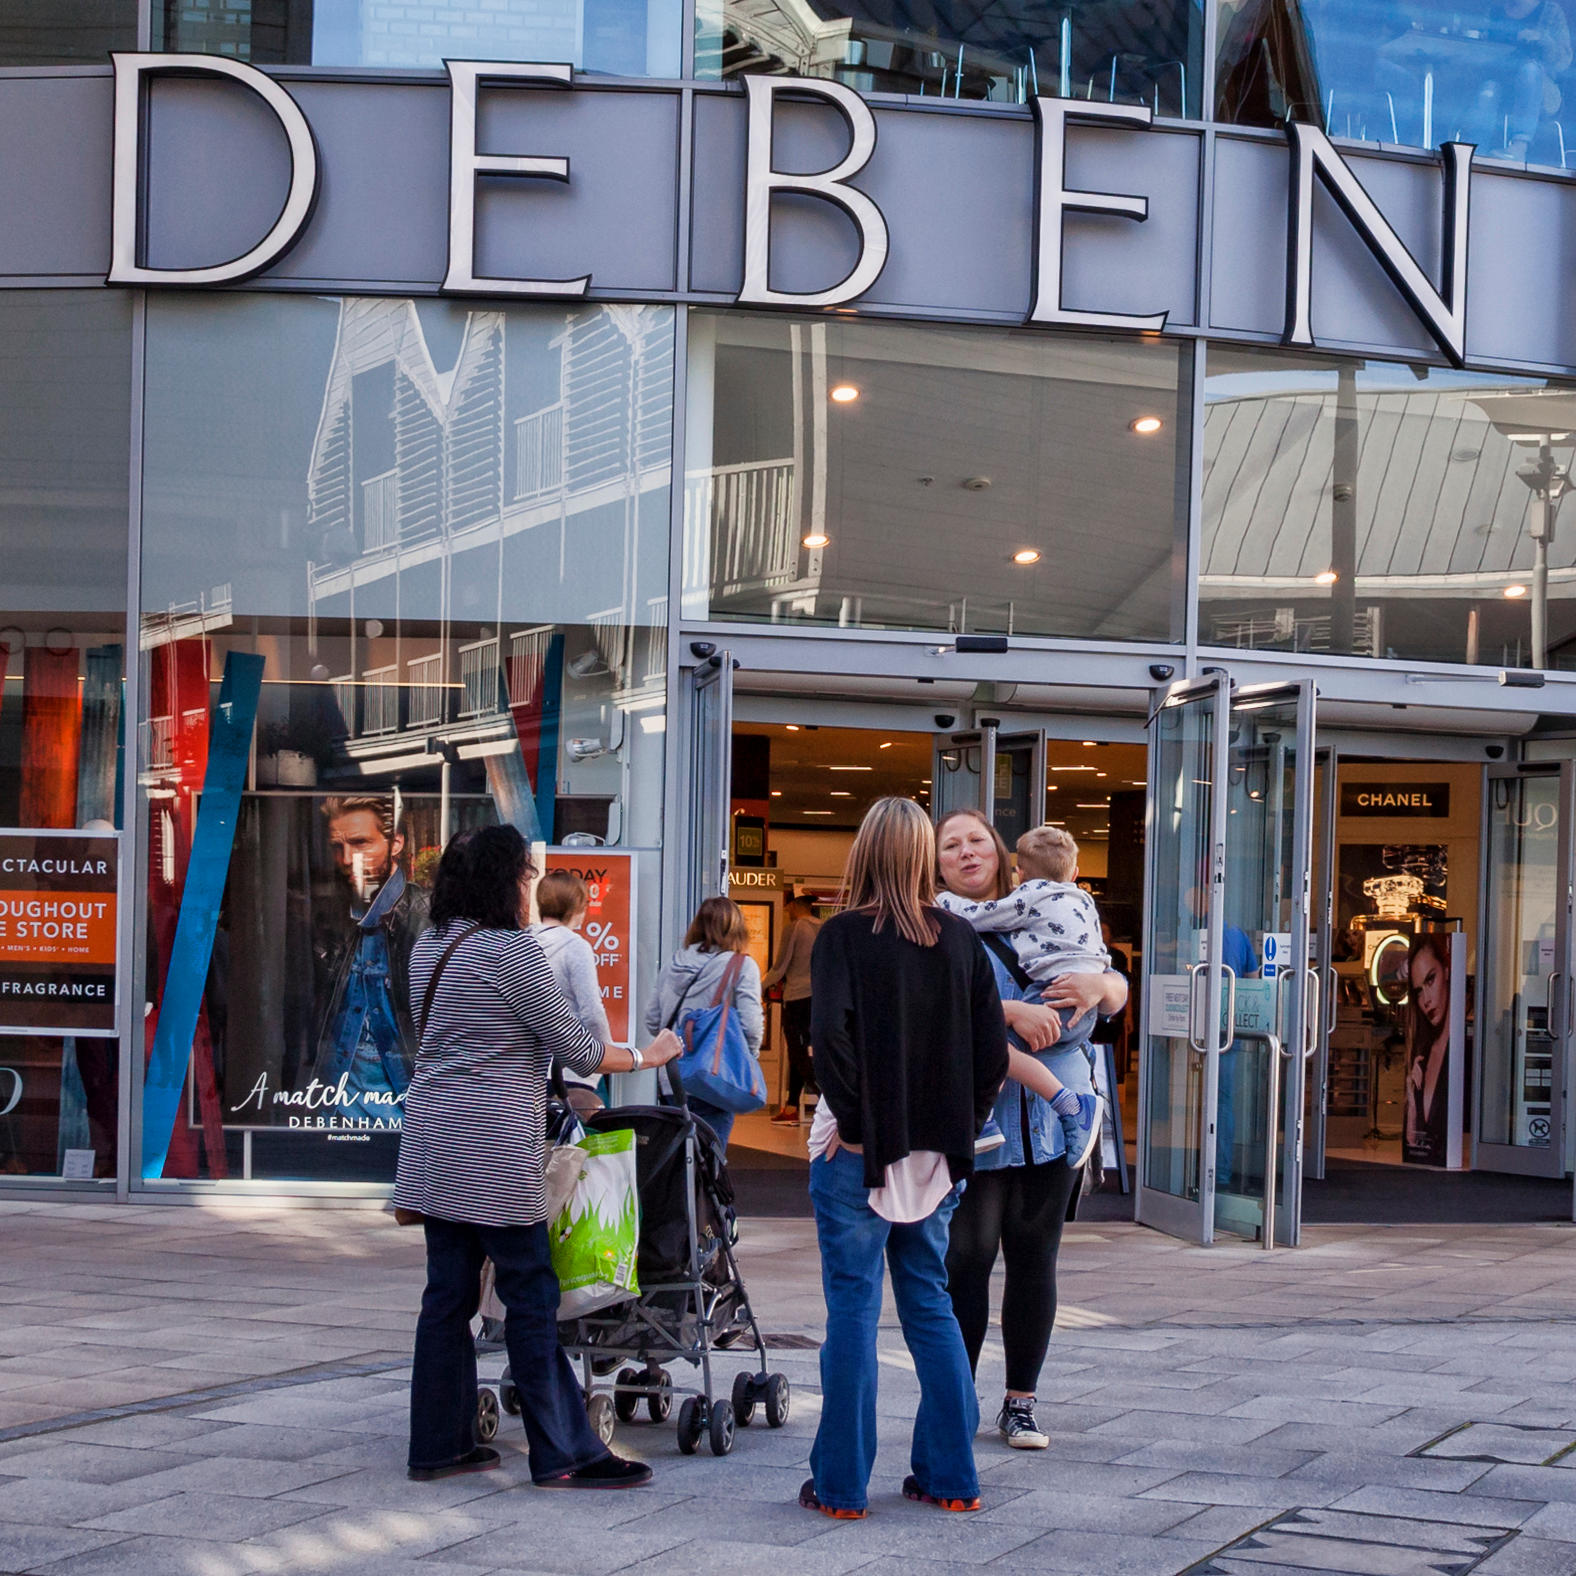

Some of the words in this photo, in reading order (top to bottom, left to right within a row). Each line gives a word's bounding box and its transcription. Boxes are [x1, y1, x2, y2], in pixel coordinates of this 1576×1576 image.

[1356, 793, 1432, 807] CHANEL
[727, 872, 777, 887] AUDER
[16, 921, 89, 939] STORE
[2, 982, 106, 996] FRAGRANCE
[230, 1071, 269, 1112] A
[273, 1071, 360, 1110] match
[289, 1116, 402, 1129] DEBENHAM
[327, 1133, 371, 1142] #matchmade
